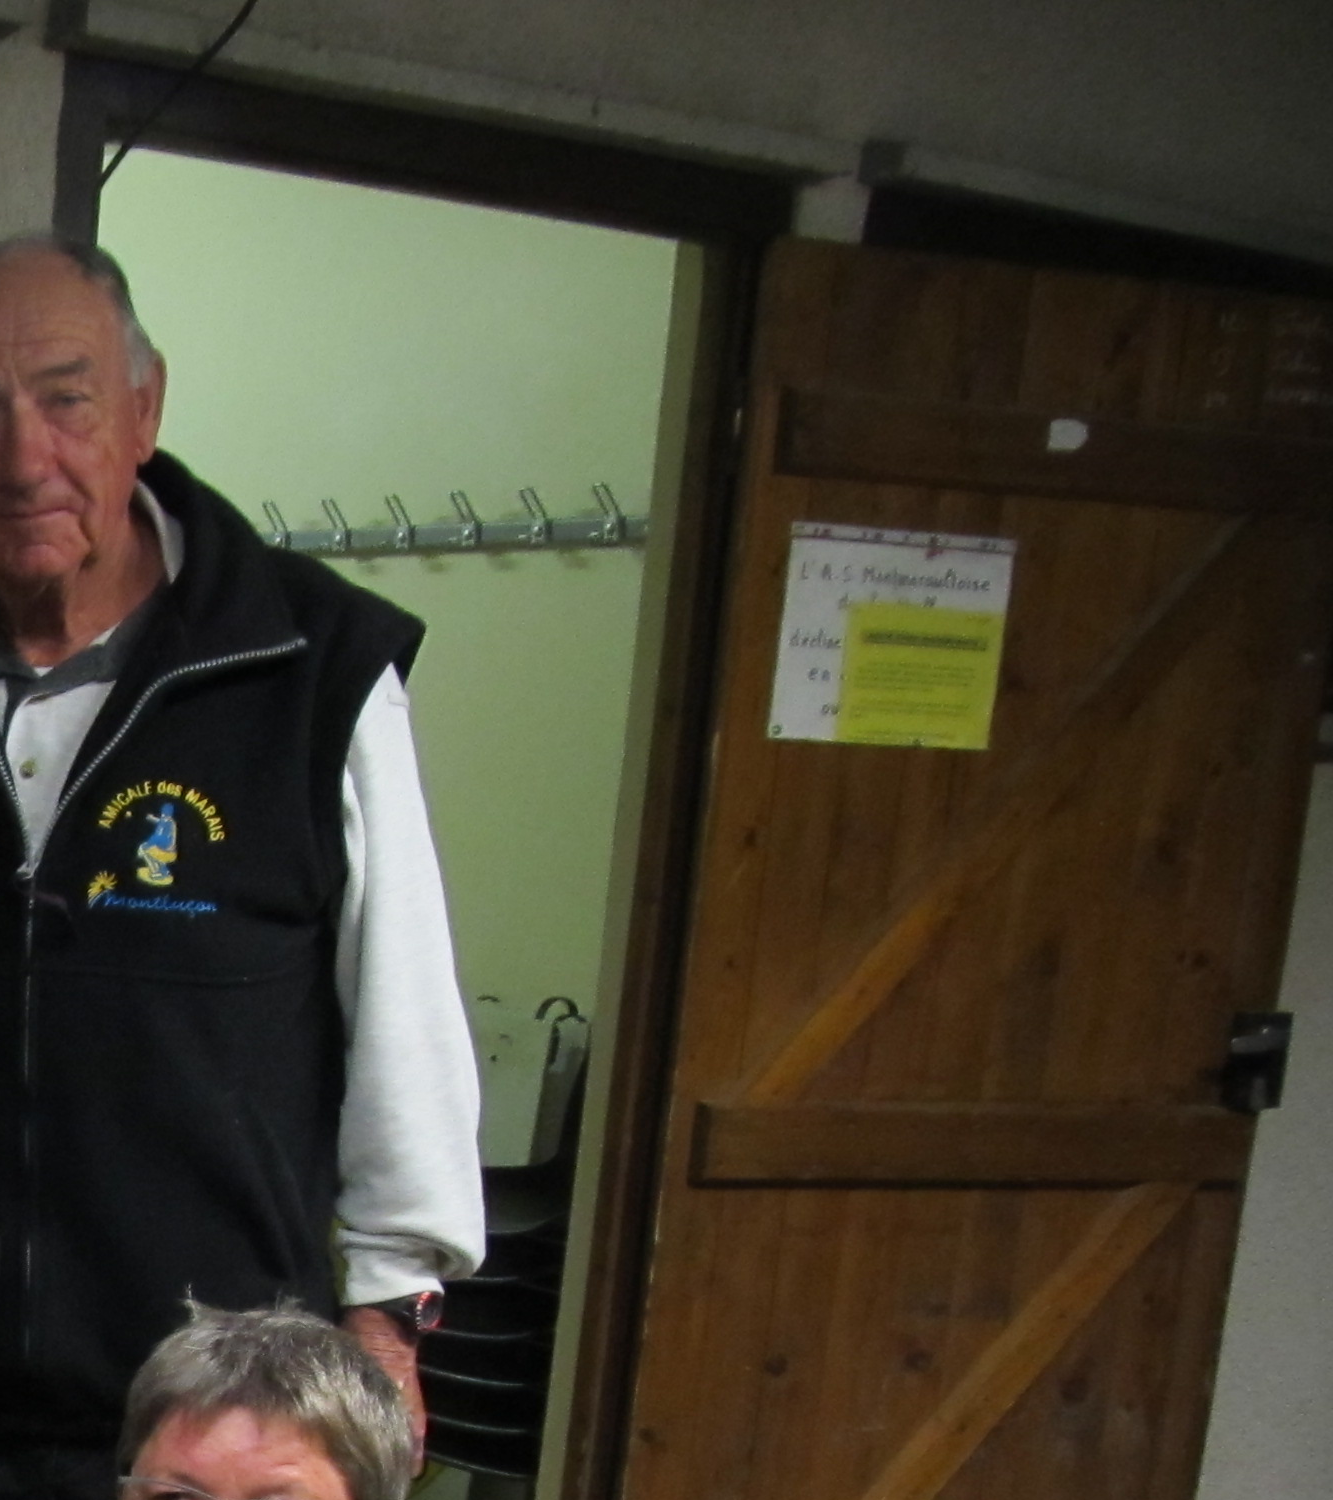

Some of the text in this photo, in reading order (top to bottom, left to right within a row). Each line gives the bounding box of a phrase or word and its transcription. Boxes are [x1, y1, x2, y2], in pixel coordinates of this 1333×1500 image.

[98, 780, 226, 842] AMICALE des MARAIS
